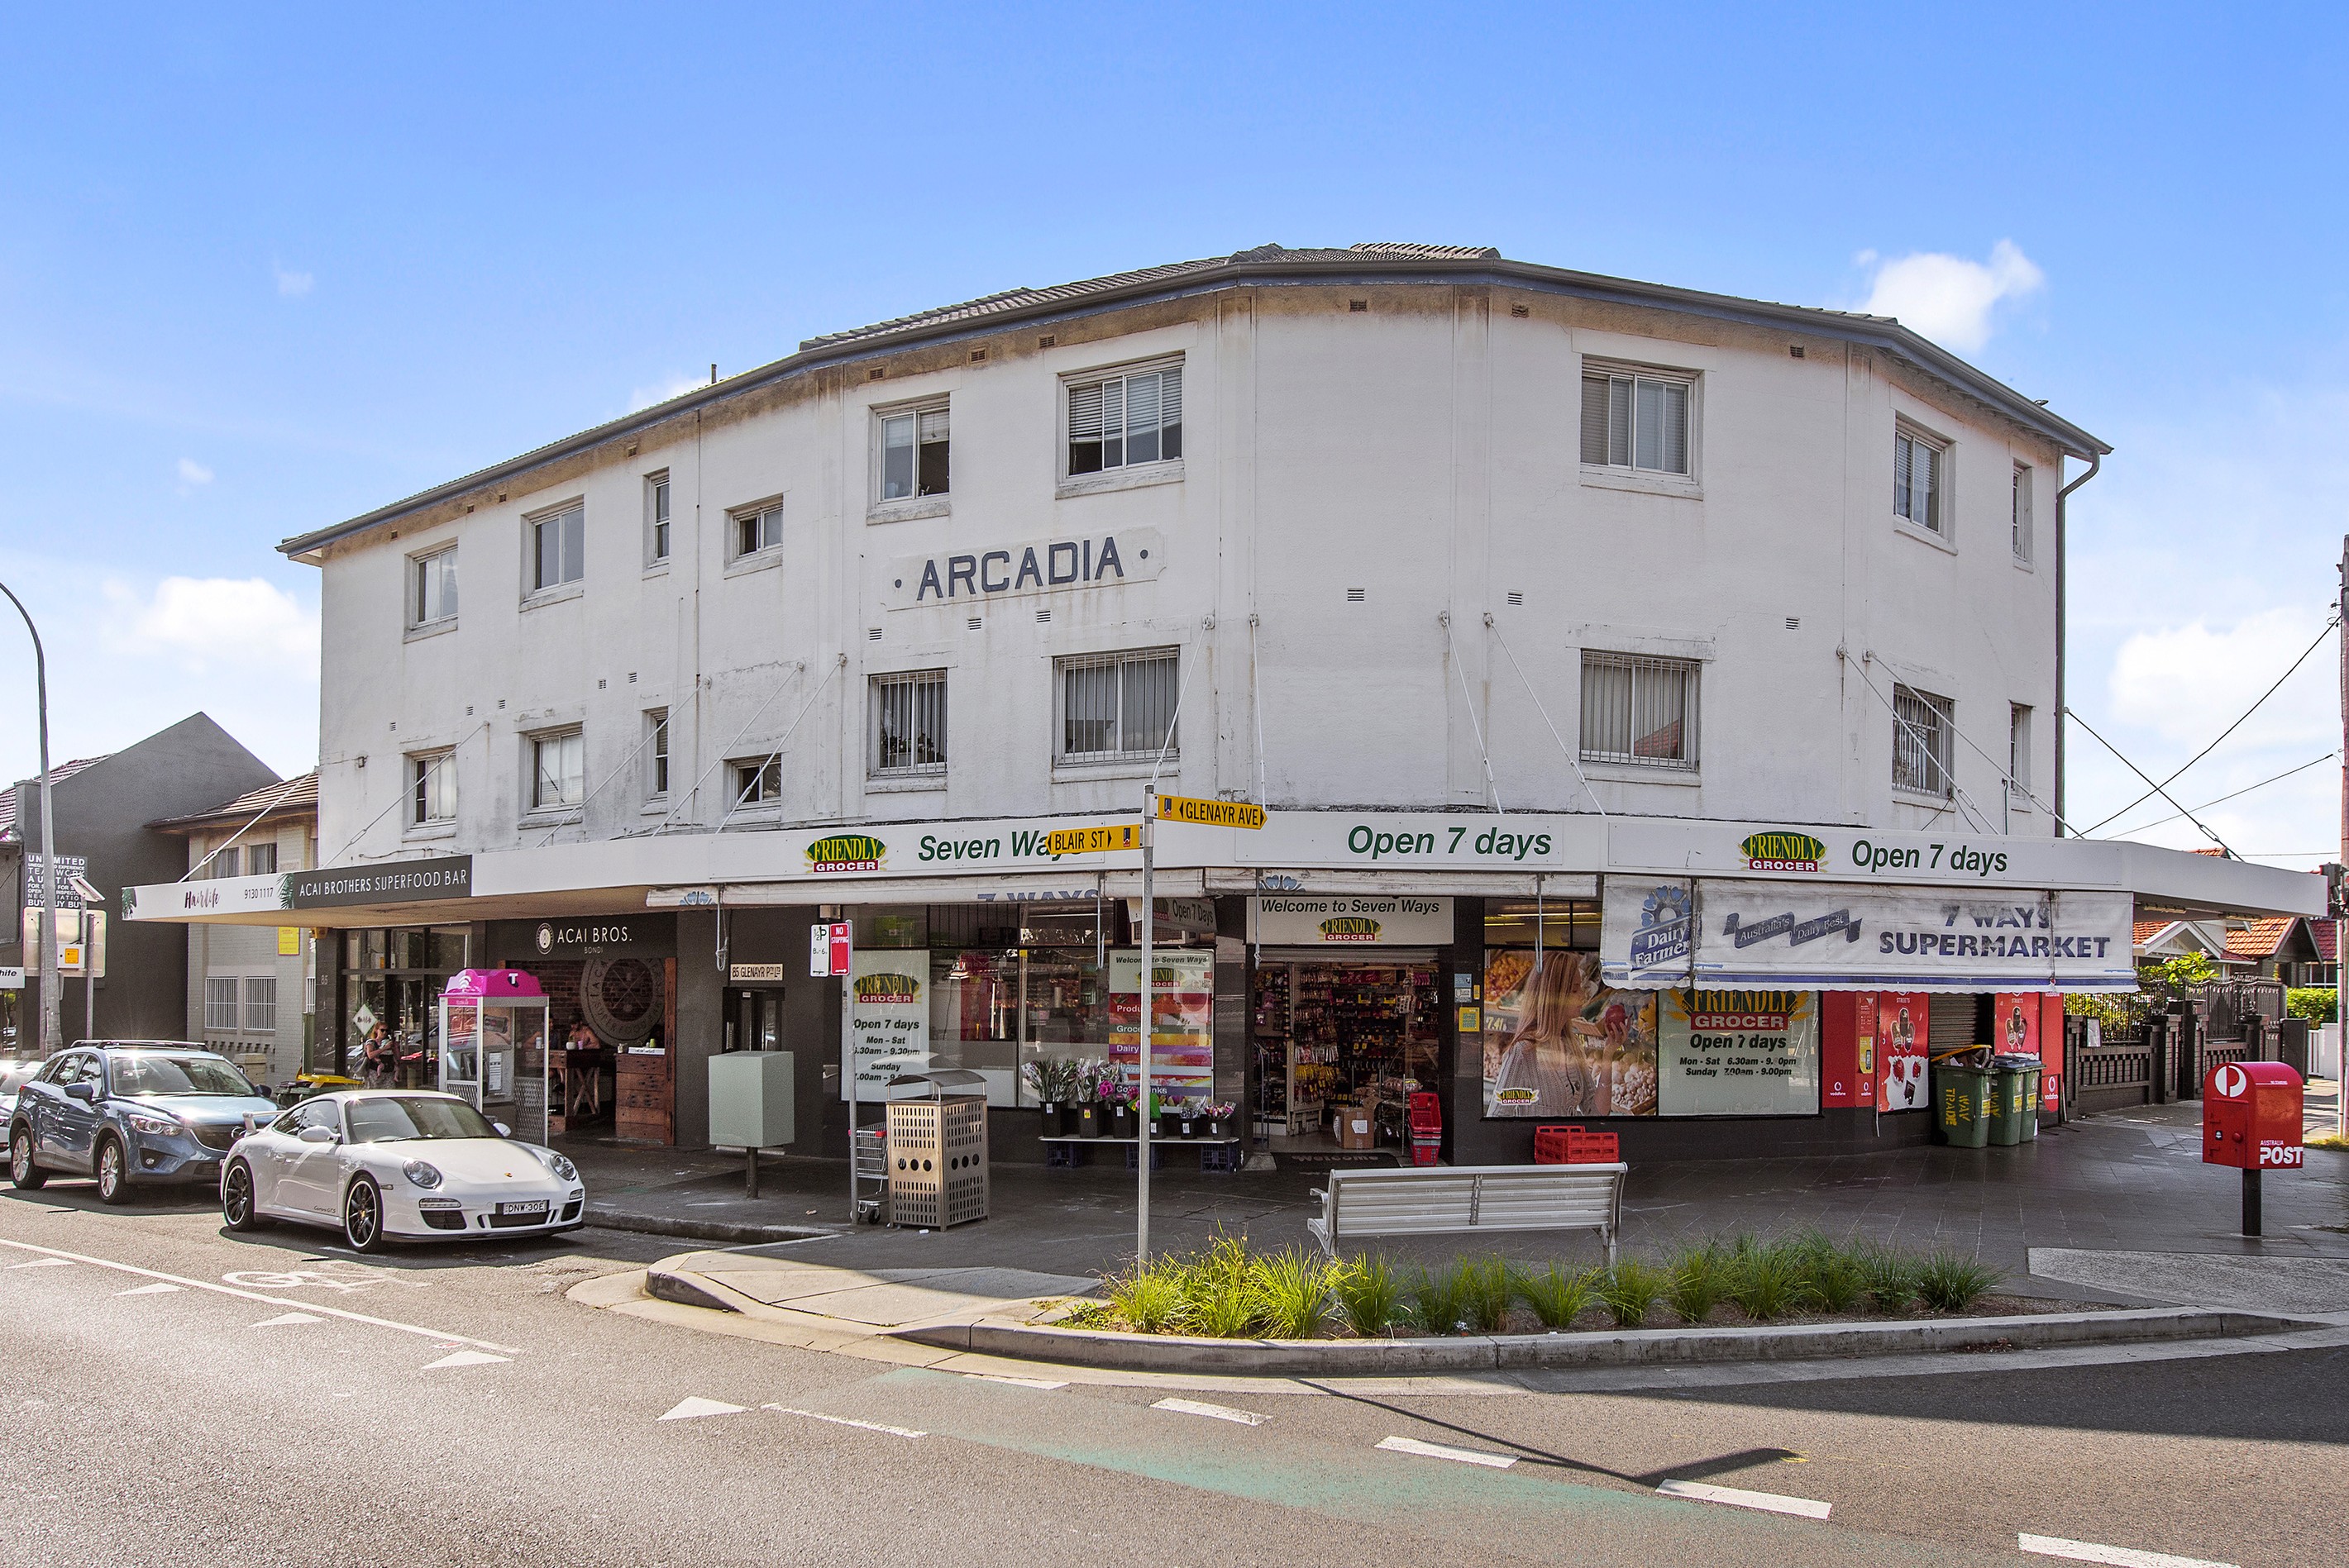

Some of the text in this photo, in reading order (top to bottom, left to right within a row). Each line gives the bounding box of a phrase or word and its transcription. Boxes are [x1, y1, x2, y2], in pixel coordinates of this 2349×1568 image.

[916, 536, 1124, 601] ARCADIA
[1186, 802, 1258, 826] GLENAYR AVE
[814, 837, 880, 861] FRIENDLY
[918, 835, 1000, 861] Seven
[1055, 831, 1105, 851] BLAIR ST
[1348, 825, 1552, 860] Open 7 days
[1749, 834, 1819, 860] FRIENDLY
[28, 855, 84, 865] UNMITED
[816, 862, 876, 871] GROCER
[1751, 860, 1815, 872] GROCER
[1852, 840, 2008, 877] Open 7 days
[299, 870, 466, 897] ACAI BROTHERS SUPERFOOD BAR
[245, 888, 273, 898] 9130 1117
[1262, 899, 1439, 915] Welcome to Seven Ways
[1325, 917, 1376, 934] FRIENDLY
[1943, 906, 2050, 929] 7 WAYS
[557, 928, 587, 943] ACAI
[593, 927, 632, 942] BROS.
[836, 927, 843, 935] NO
[1740, 915, 1844, 941] Australia's Dairy Best
[1648, 927, 1687, 949] Dairy
[1879, 932, 2111, 959] SUPERMARKET
[1186, 956, 1207, 965] Ways
[1635, 940, 1689, 968] Farmer
[733, 966, 739, 977] 85
[741, 966, 765, 977] GLENAYR
[860, 975, 914, 994] FRIENDLY
[1694, 990, 1788, 1013] FRIENDLY
[854, 1019, 919, 1031] Open 7 days
[1695, 1015, 1783, 1028] GROCER
[1116, 1045, 1139, 1054] Dairy
[1690, 1034, 1787, 1051] Open 7 days
[890, 1047, 920, 1056] 9.30pm
[871, 1063, 900, 1072] Sunday
[1727, 1057, 1759, 1065] 6.30am
[1686, 1068, 1717, 1077] Sunday
[1761, 1068, 1792, 1077] 9.00pm
[1502, 1089, 1530, 1099] FRIENDLY
[1946, 1088, 1958, 1126] TRADE
[2260, 1146, 2304, 1165] POST
